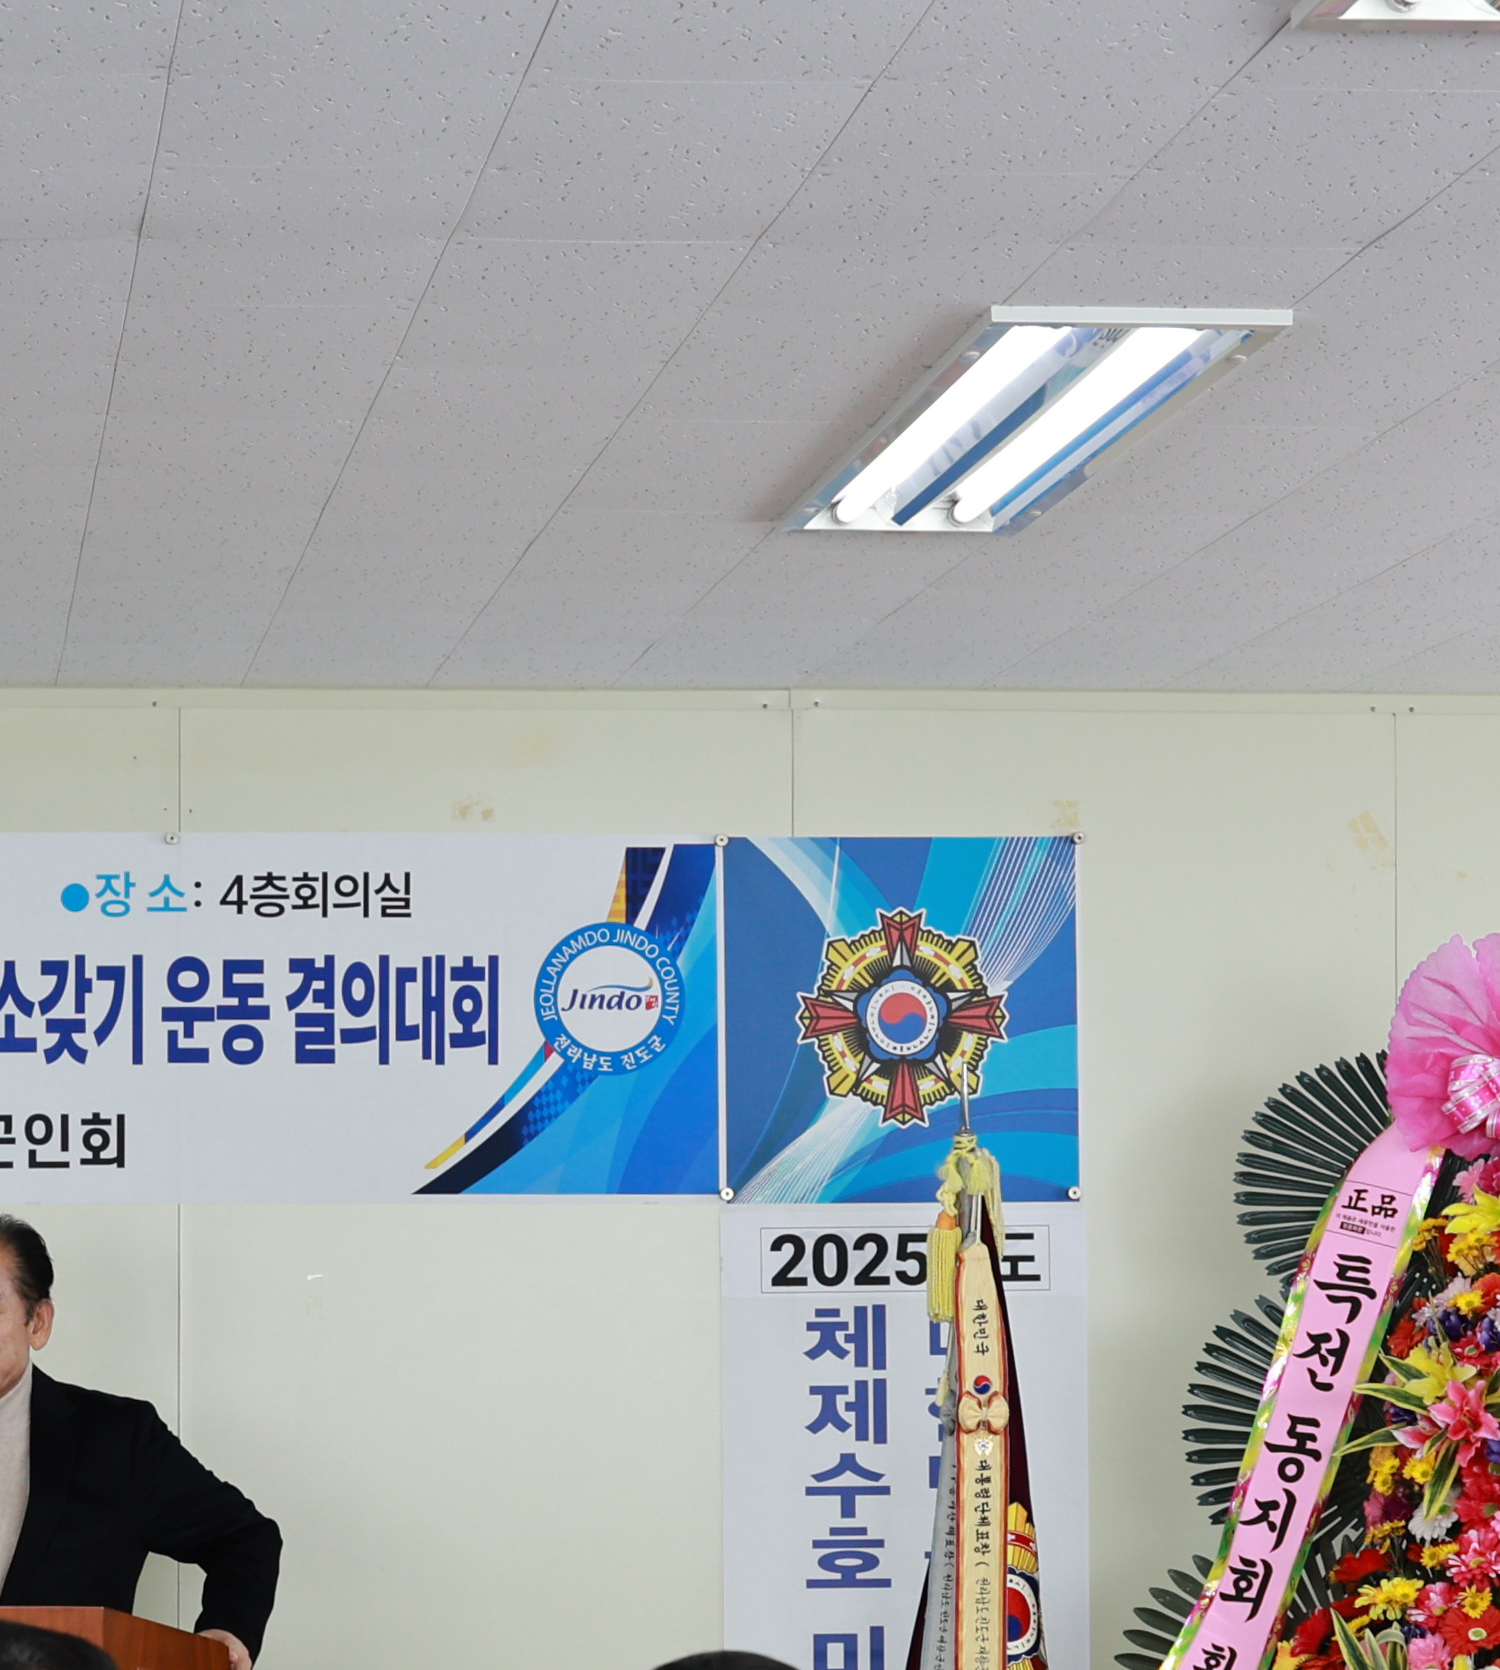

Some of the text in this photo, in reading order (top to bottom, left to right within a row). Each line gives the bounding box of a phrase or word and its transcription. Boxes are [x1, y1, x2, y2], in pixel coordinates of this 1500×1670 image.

[220, 872, 413, 919] 4층회의실
[539, 928, 681, 1026] JEOLLANAMDO JINDO COUNTY
[560, 988, 643, 1012] Jindo
[162, 957, 271, 1066] 운동
[287, 956, 500, 1066] 결의대회
[553, 1033, 667, 1072] 전라남도 진도군
[1341, 1188, 1399, 1219] 正品
[769, 1232, 1041, 1287] 2025도
[972, 1299, 990, 1356] 대한민국
[802, 1304, 892, 1589] 체제수호
[1218, 1252, 1378, 1623] 특전동지회
